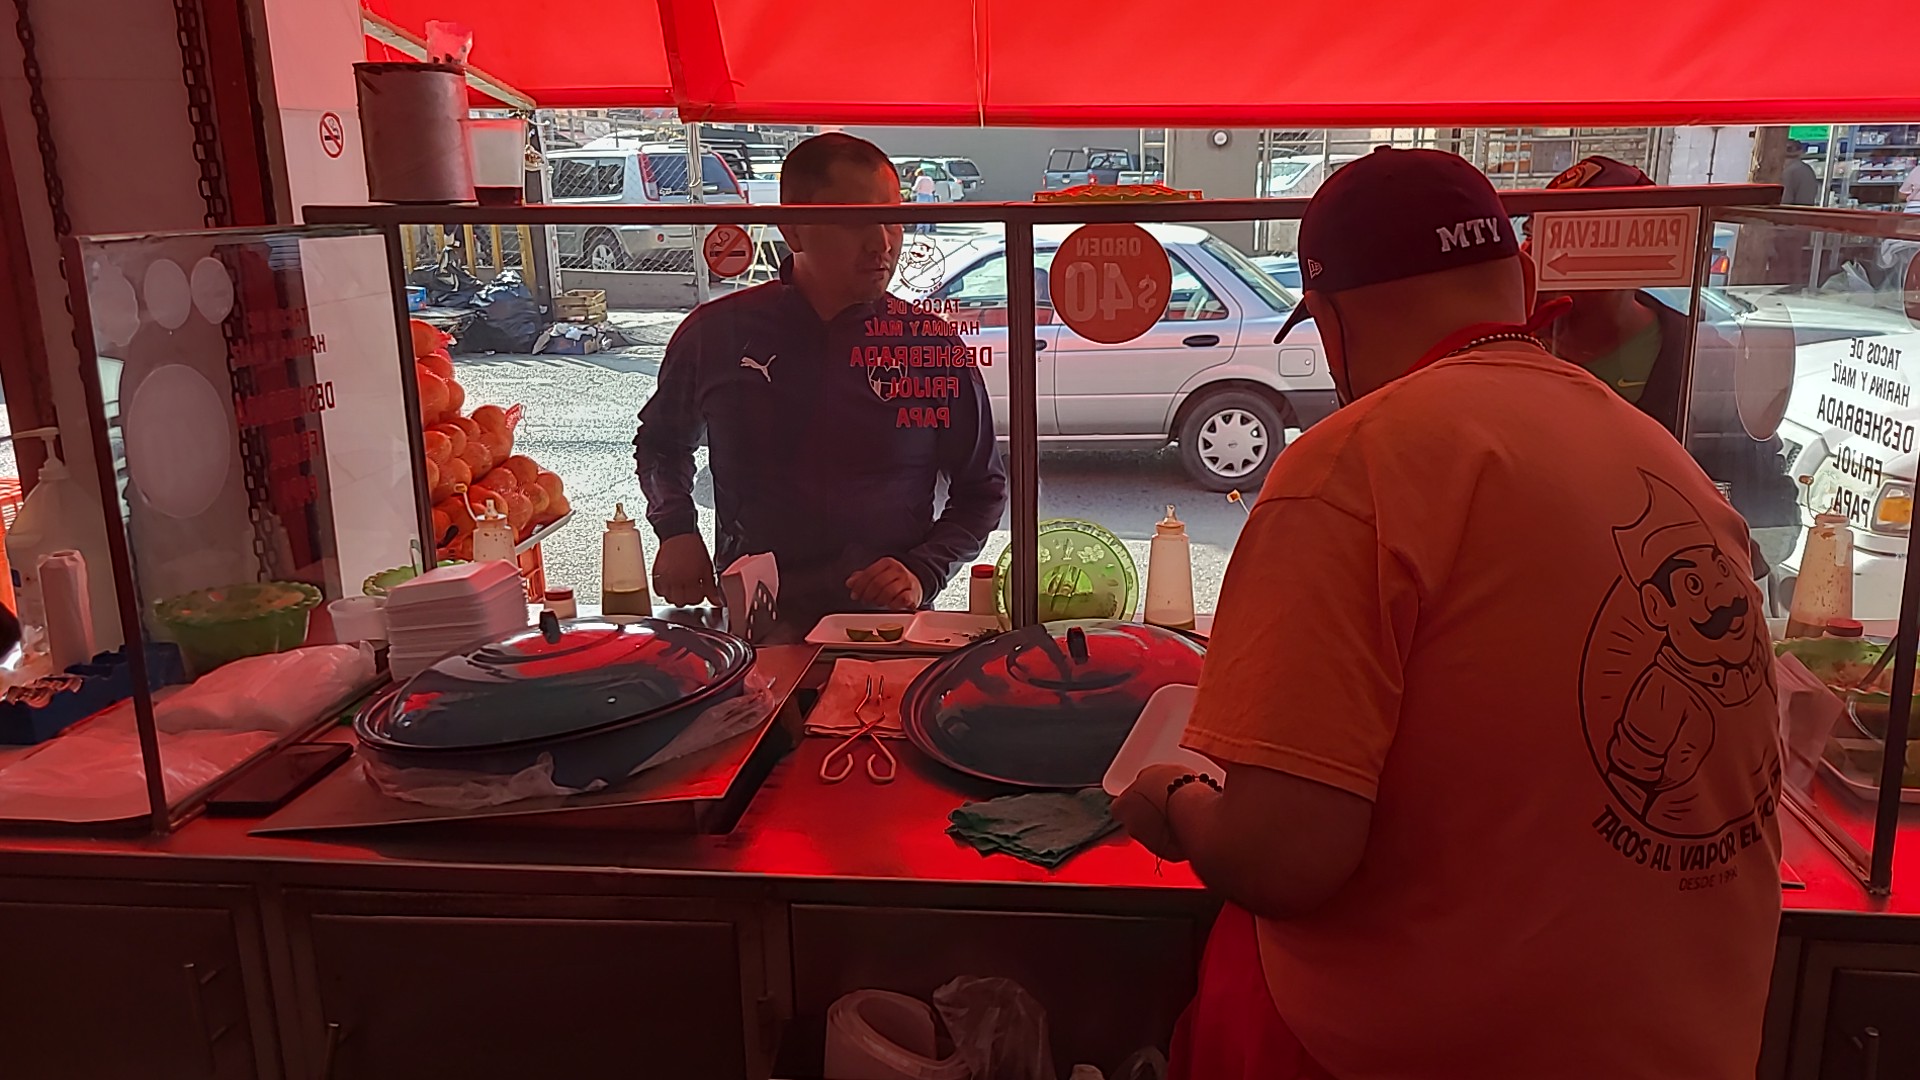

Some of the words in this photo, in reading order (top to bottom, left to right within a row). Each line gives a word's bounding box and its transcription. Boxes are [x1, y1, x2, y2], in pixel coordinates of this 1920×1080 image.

[1436, 217, 1501, 252] MTY
[1592, 804, 1652, 865] TACOS
[1650, 843, 1672, 872] AL
[1680, 832, 1737, 872] VAPOR
[1739, 821, 1762, 850] EL
[1679, 874, 1715, 891] DESDE
